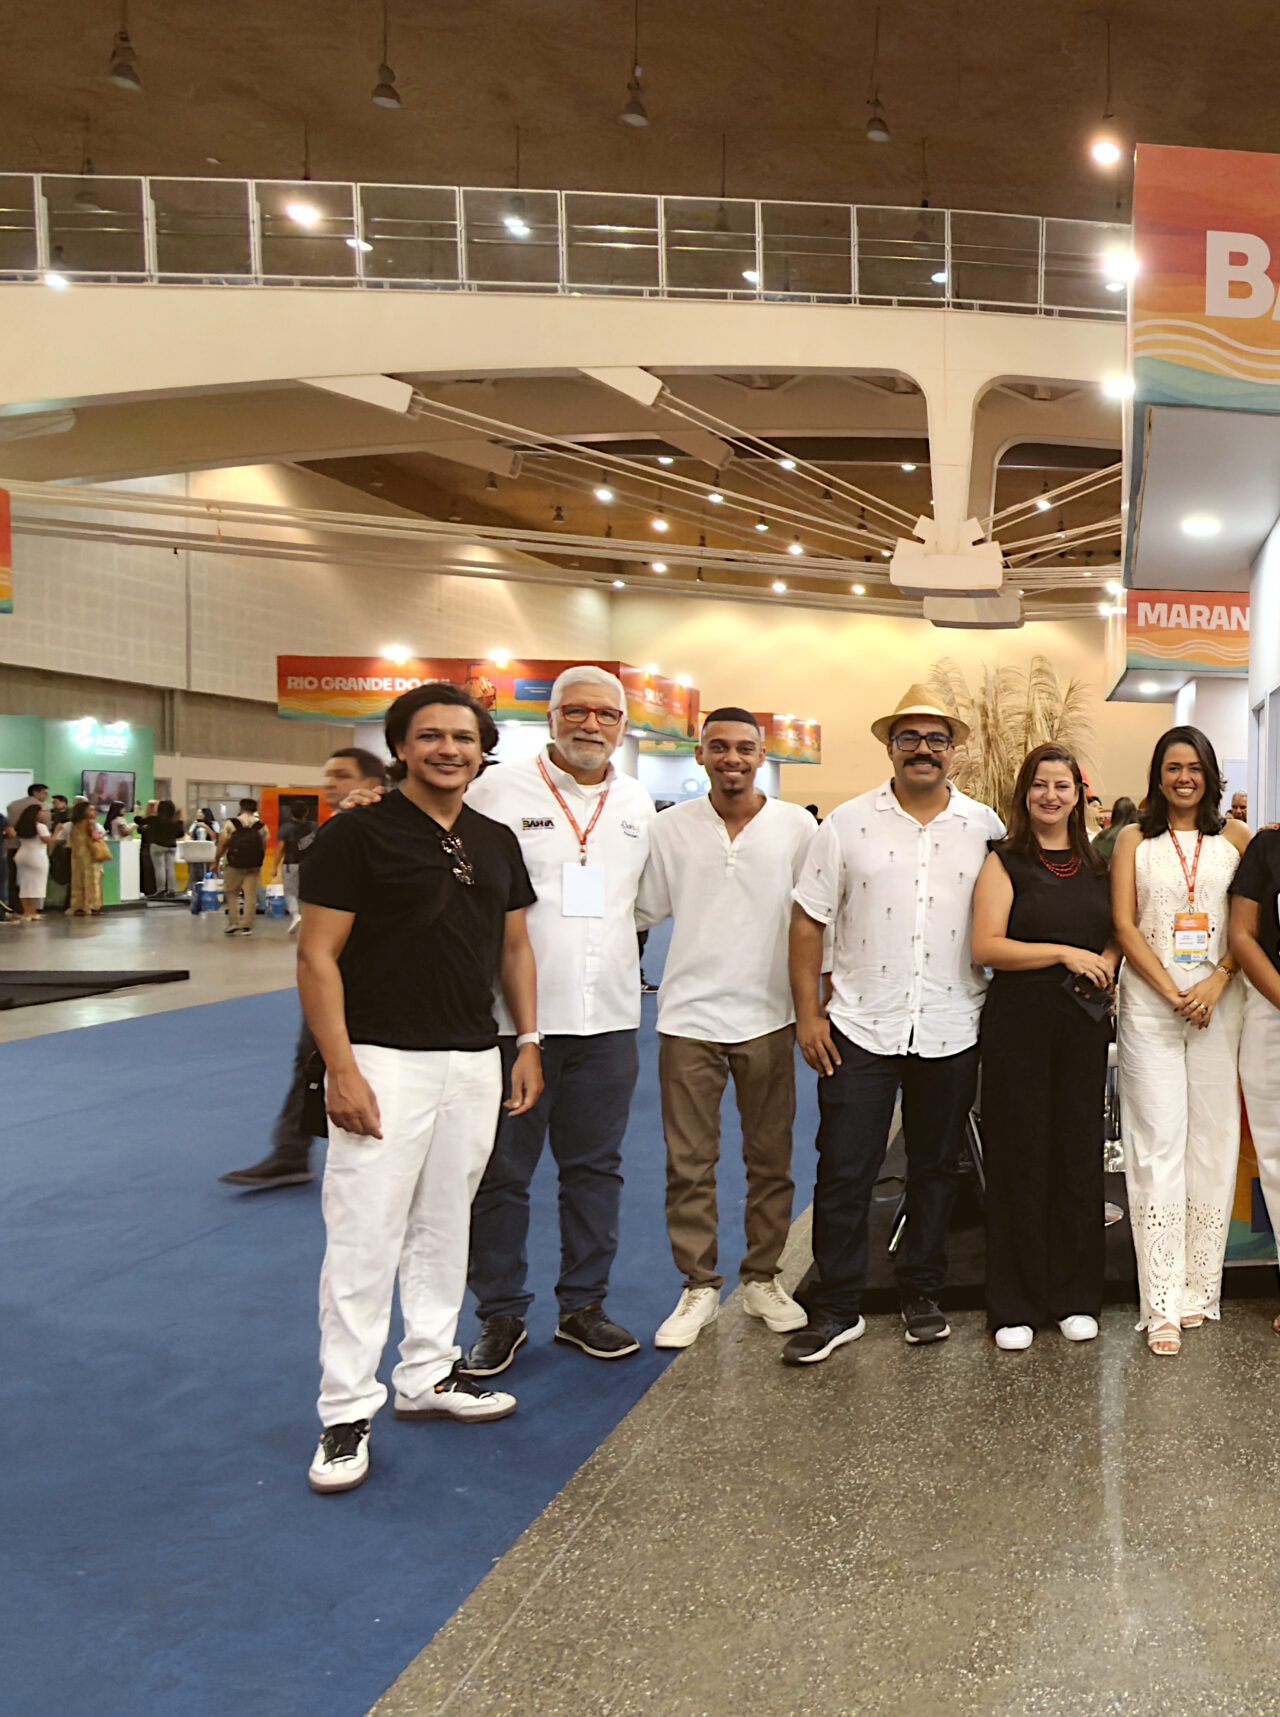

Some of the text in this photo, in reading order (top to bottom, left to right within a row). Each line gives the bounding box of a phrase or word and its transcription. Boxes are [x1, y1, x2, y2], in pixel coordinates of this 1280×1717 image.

[286, 676, 319, 690] RIO
[321, 677, 393, 691] GRANDE
[395, 678, 422, 691] DO
